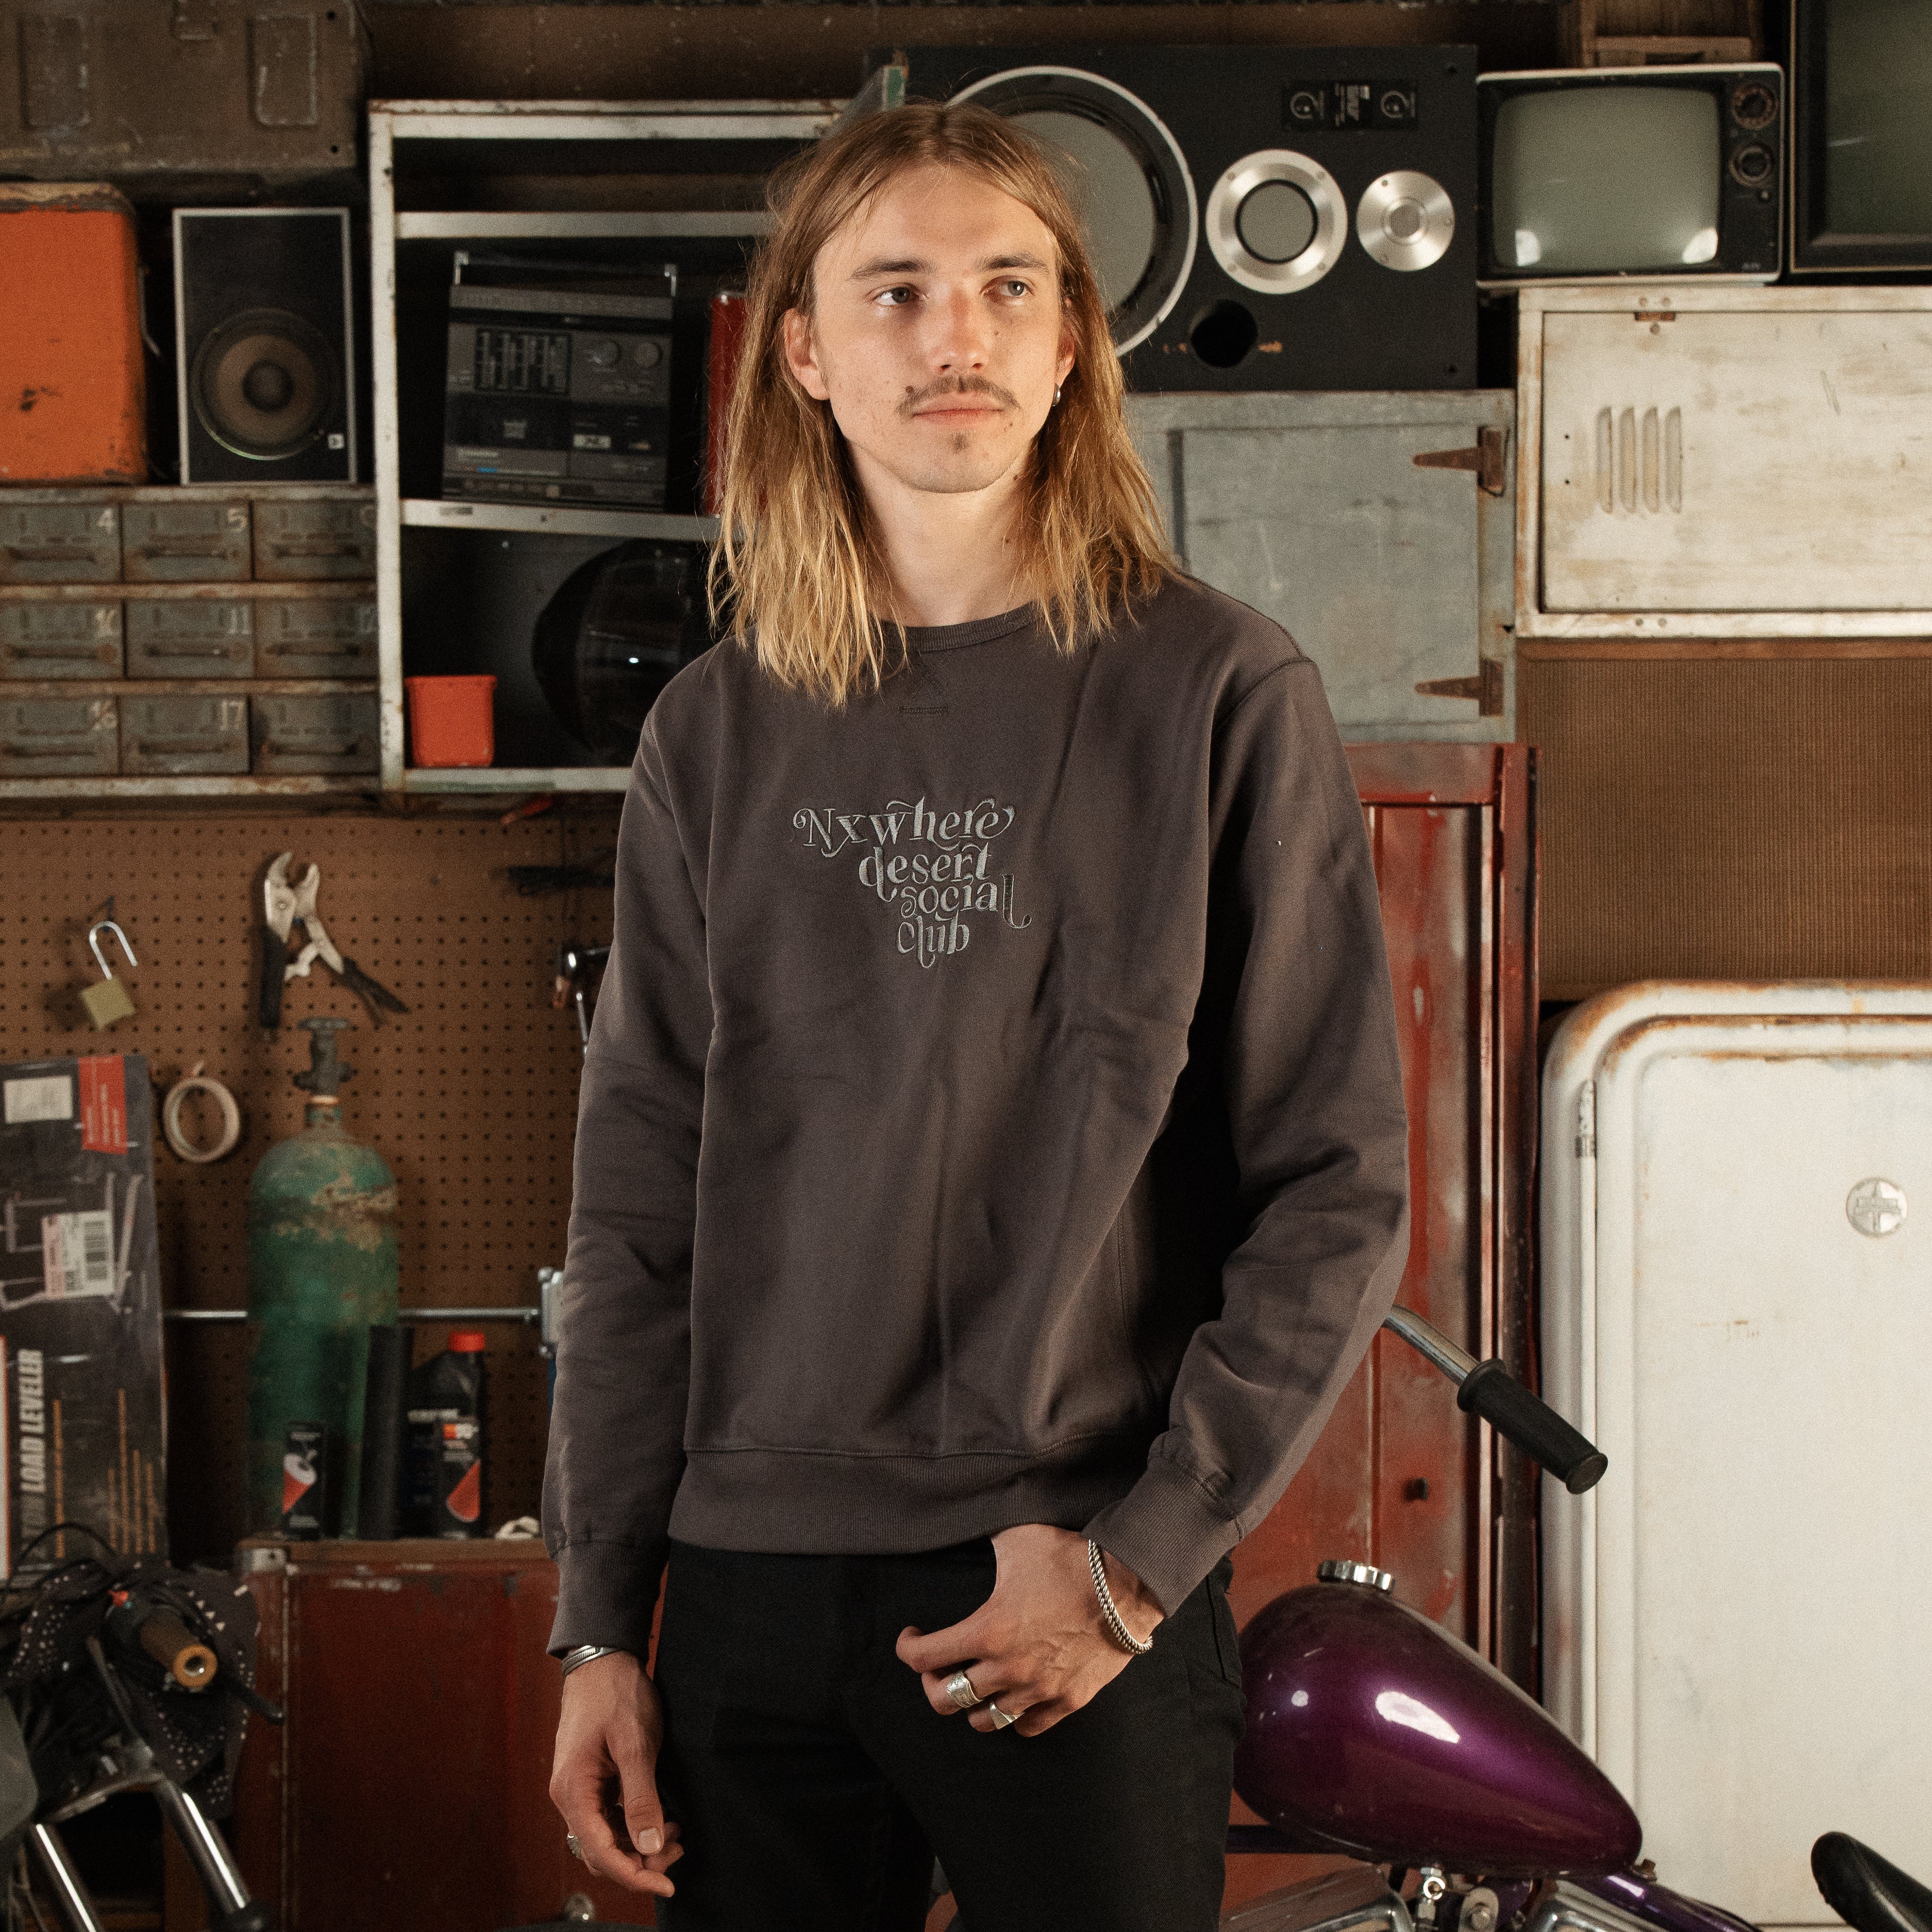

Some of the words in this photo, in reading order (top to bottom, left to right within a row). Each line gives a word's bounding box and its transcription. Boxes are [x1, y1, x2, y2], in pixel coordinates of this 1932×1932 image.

[96, 508, 115, 535] 4
[226, 508, 247, 532] 5
[228, 607, 249, 635] 11
[220, 701, 245, 731] 17
[859, 842, 992, 902] desert
[900, 873, 1032, 929] social
[897, 910, 970, 968] club
[18, 1349, 45, 1434] LEVELER
[20, 1437, 46, 1493] LOAD
